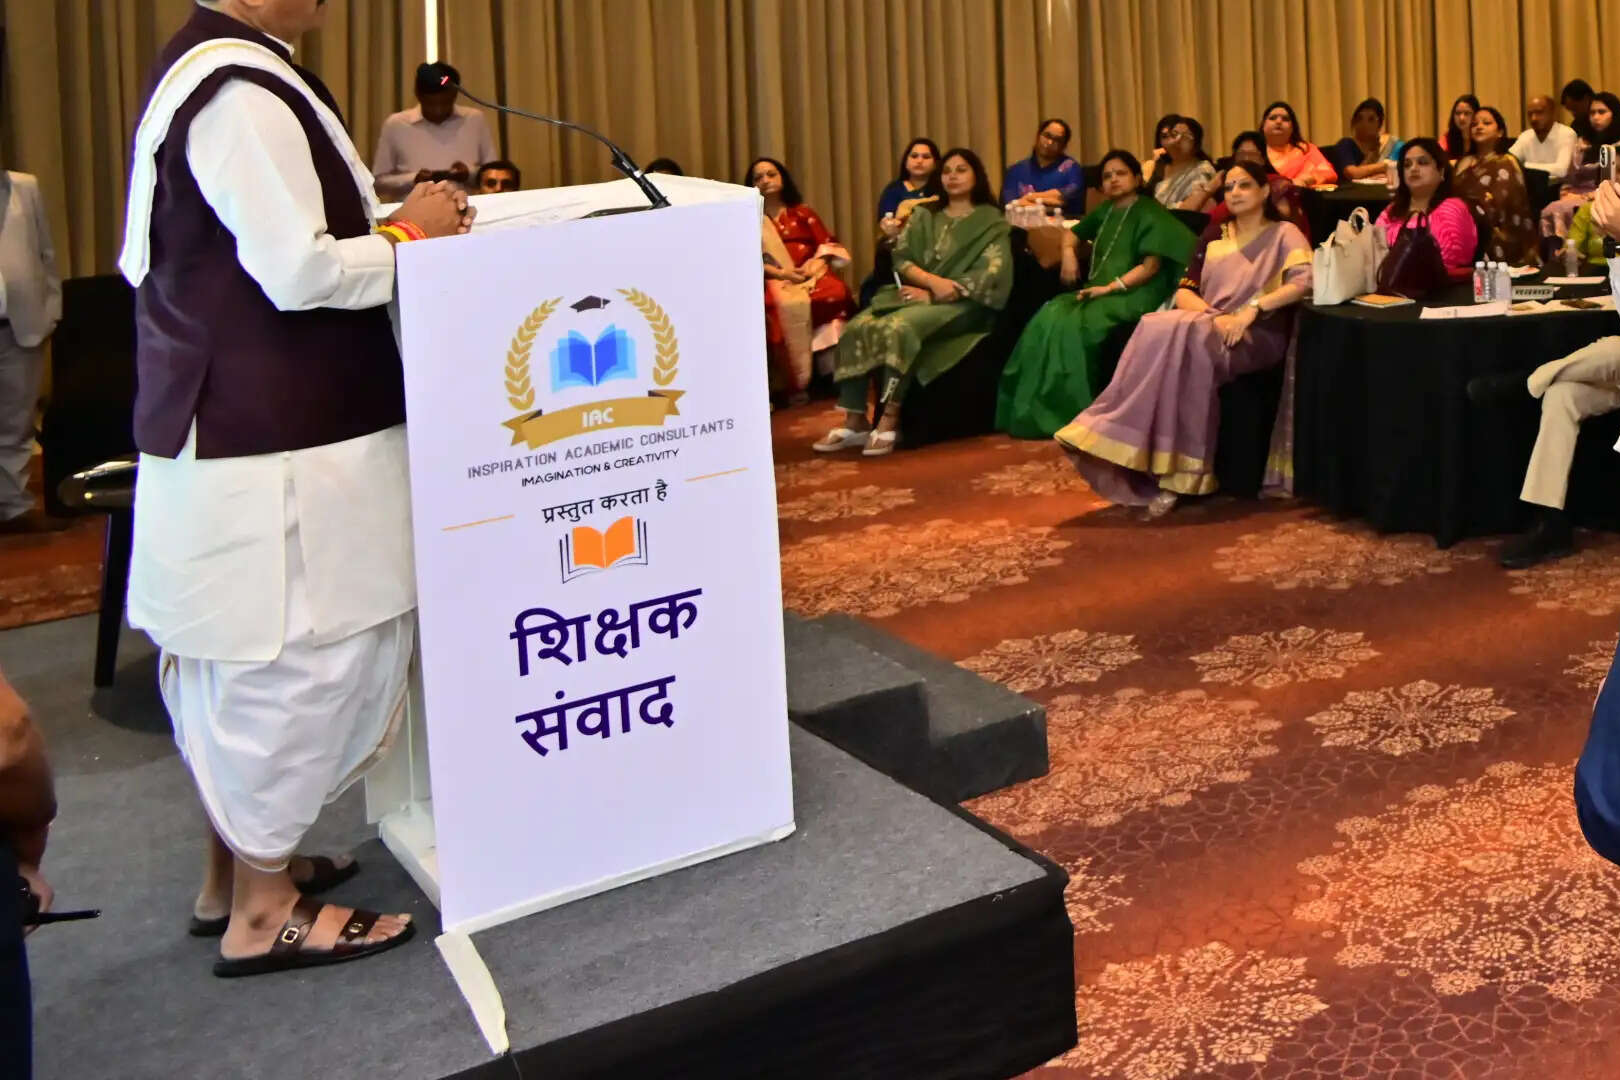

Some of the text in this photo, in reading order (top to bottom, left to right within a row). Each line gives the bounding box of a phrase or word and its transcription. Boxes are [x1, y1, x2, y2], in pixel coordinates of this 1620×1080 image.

[582, 407, 614, 427] IAC
[467, 418, 735, 480] INSPIRATION ACADEMIC CONSULTANTS
[521, 448, 681, 487] IMAGINATION & CREATIVITY
[541, 479, 669, 524] प्रस्तुत करता है
[509, 588, 703, 677] शिक्षक
[514, 675, 676, 757] संवाद
